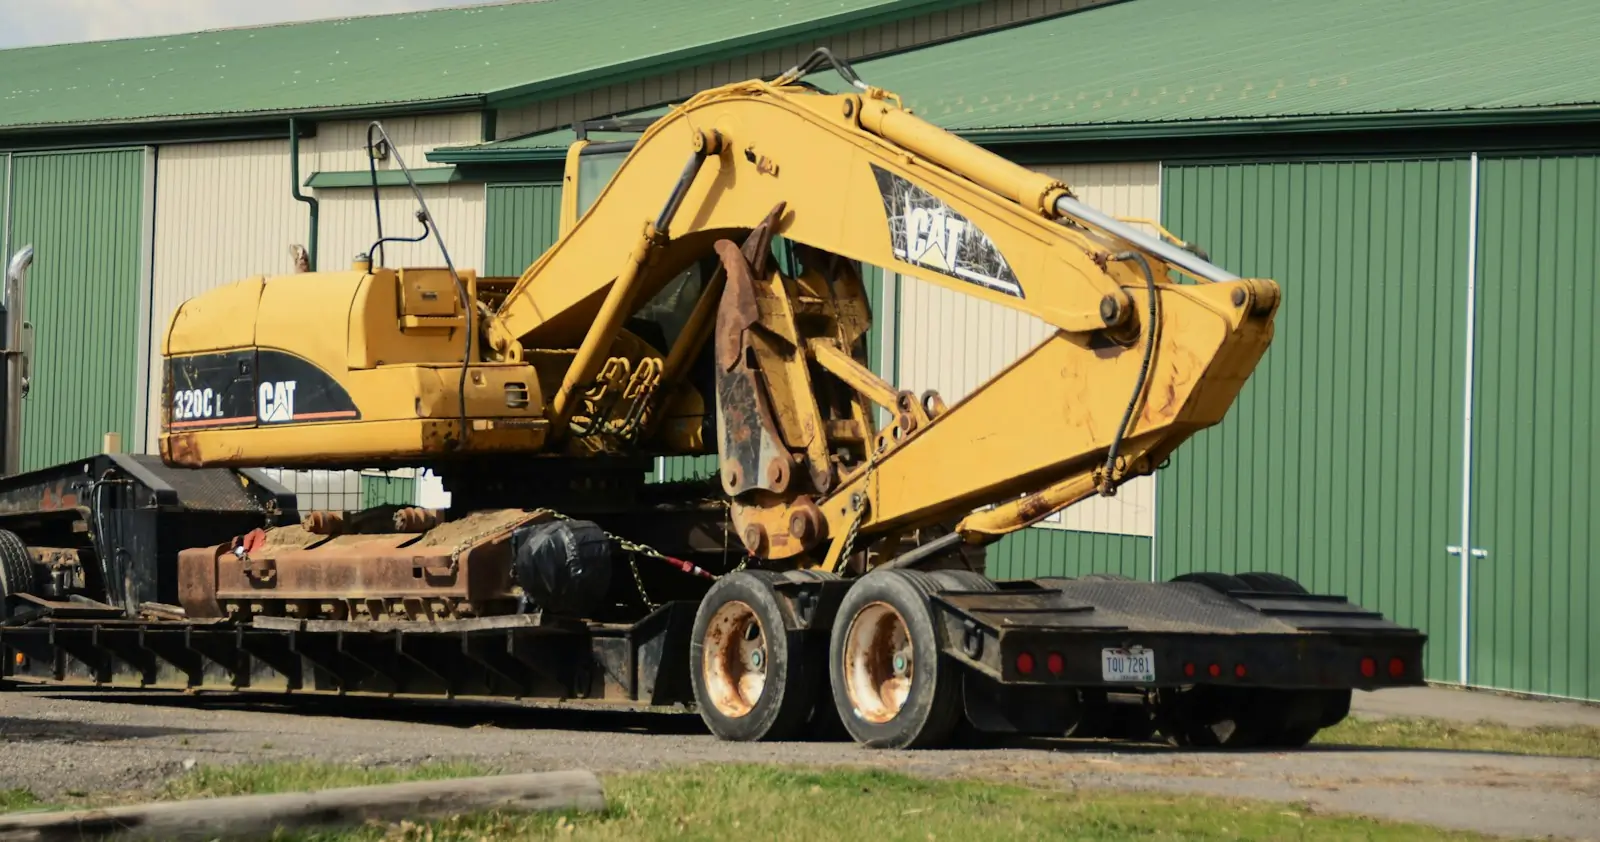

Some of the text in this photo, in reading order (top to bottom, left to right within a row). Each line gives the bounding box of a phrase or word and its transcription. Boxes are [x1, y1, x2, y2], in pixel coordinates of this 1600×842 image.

[906, 207, 965, 272] CAT
[174, 388, 213, 419] 320C
[259, 380, 296, 422] CAT
[1127, 656, 1150, 673] 7281
